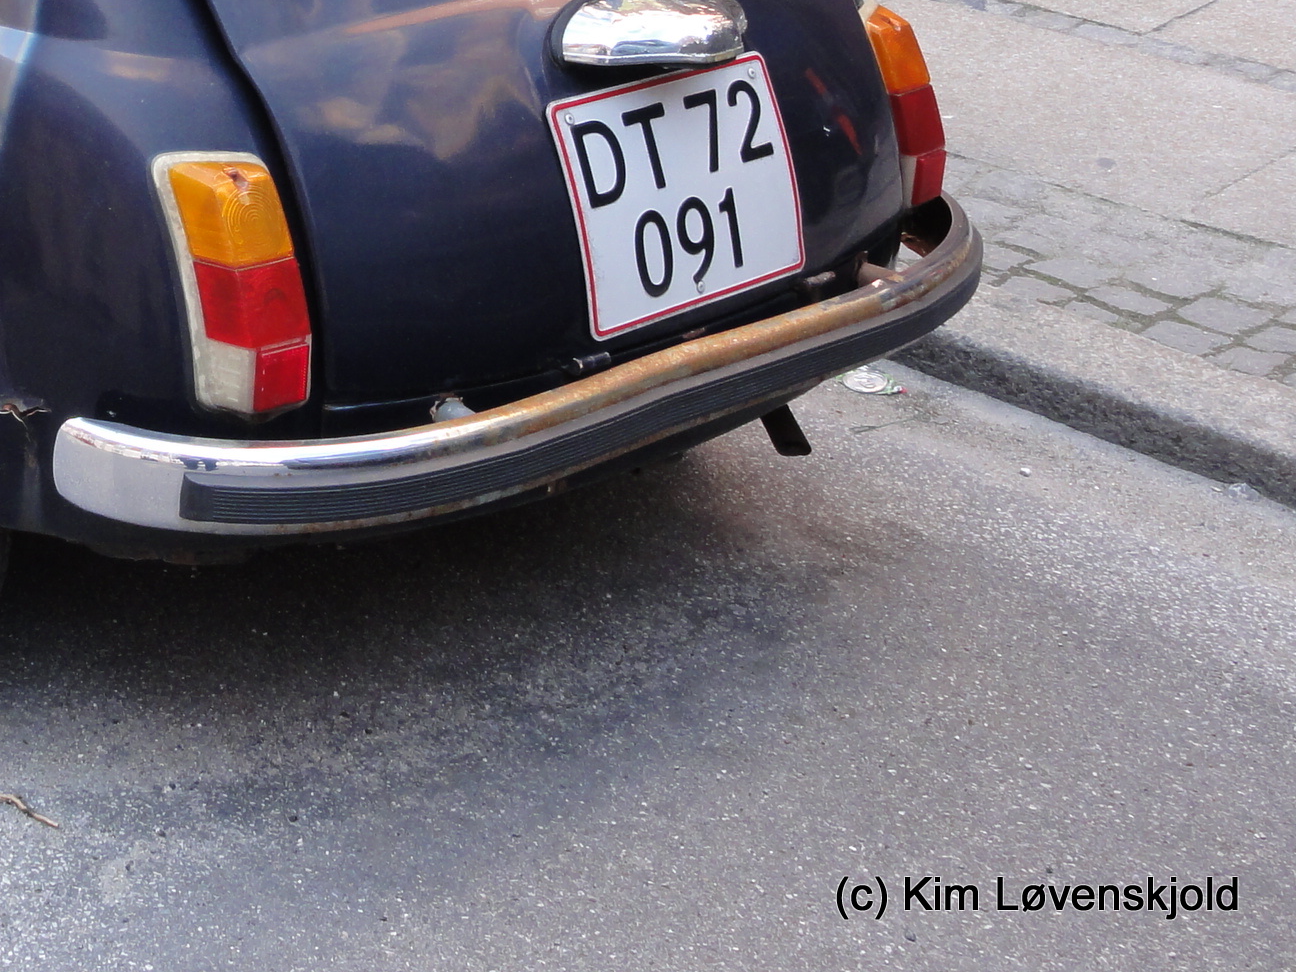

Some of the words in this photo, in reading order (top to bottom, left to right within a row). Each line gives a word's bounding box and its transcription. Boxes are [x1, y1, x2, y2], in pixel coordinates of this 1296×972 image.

[571, 102, 666, 208] DT
[683, 80, 774, 173] 72
[635, 186, 743, 297] 091
